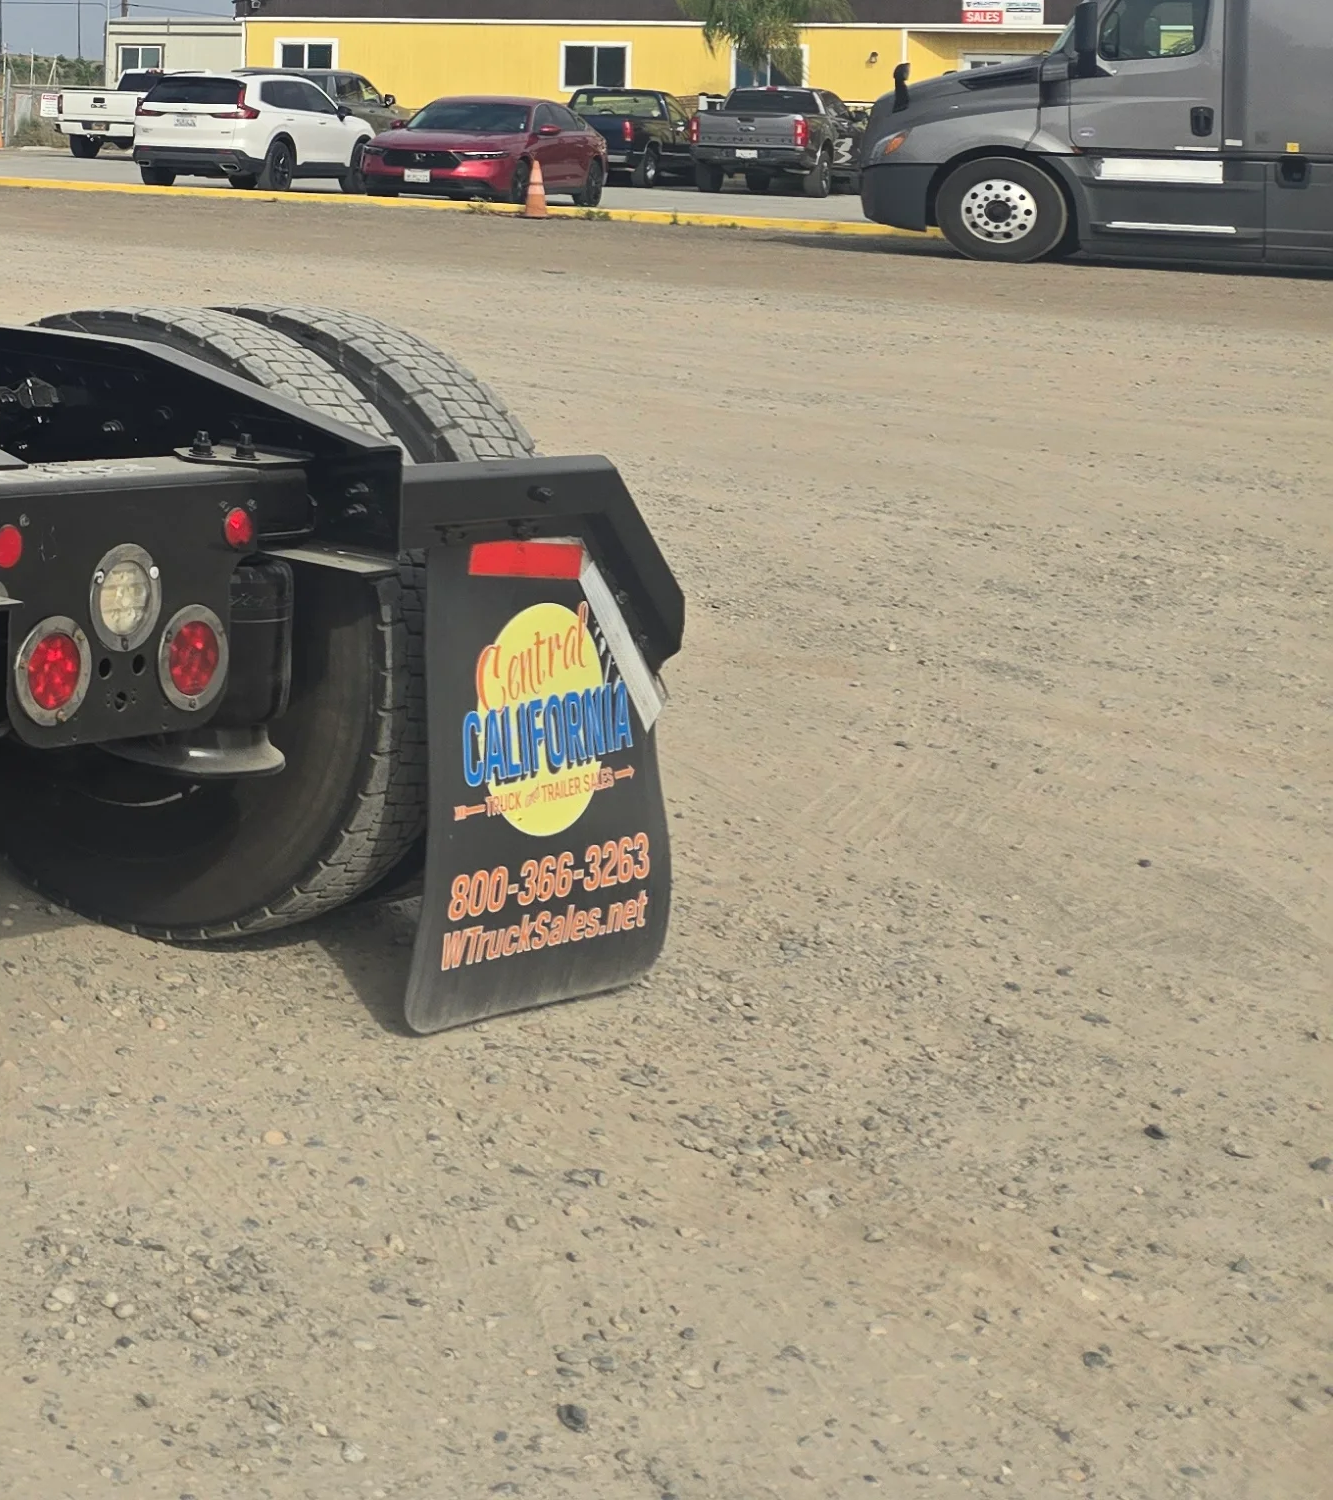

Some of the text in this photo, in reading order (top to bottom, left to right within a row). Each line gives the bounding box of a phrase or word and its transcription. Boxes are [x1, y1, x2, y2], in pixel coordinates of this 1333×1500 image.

[966, 12, 1000, 23] SALES
[476, 601, 589, 713] Central
[462, 680, 634, 787] CALIFORNIA
[485, 791, 521, 817] TRUCK
[541, 780, 582, 803] TRAILER
[583, 767, 615, 792] SALES
[448, 832, 650, 922] 800-366-3263
[441, 889, 649, 971] WTruckSales.net
